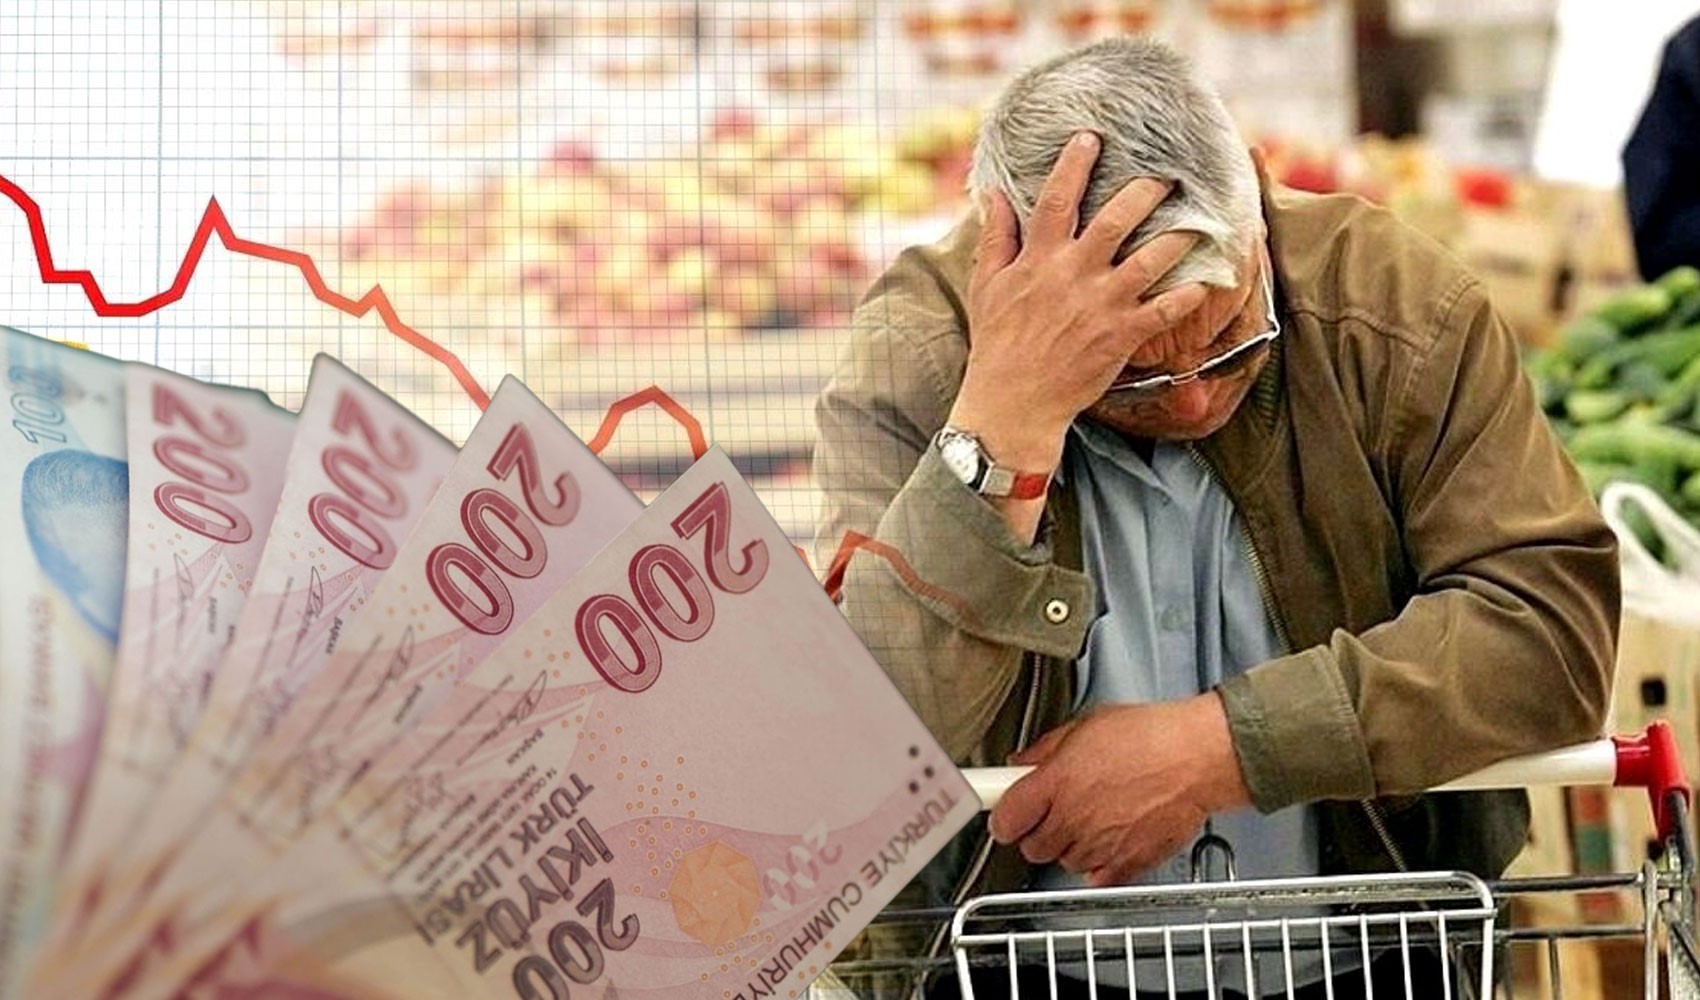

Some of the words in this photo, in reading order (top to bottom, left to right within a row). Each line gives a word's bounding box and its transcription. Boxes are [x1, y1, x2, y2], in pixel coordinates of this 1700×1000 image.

[152, 383, 253, 544] 200
[308, 391, 418, 570] 200
[425, 421, 581, 635] 200
[574, 481, 770, 694] 200
[509, 773, 595, 855] TÜRK
[763, 819, 843, 911] 200
[860, 787, 958, 889] TÜRKİYE
[413, 846, 514, 947] LİRASI
[455, 816, 615, 975] İKİYÜZ
[513, 877, 641, 1000] 200
